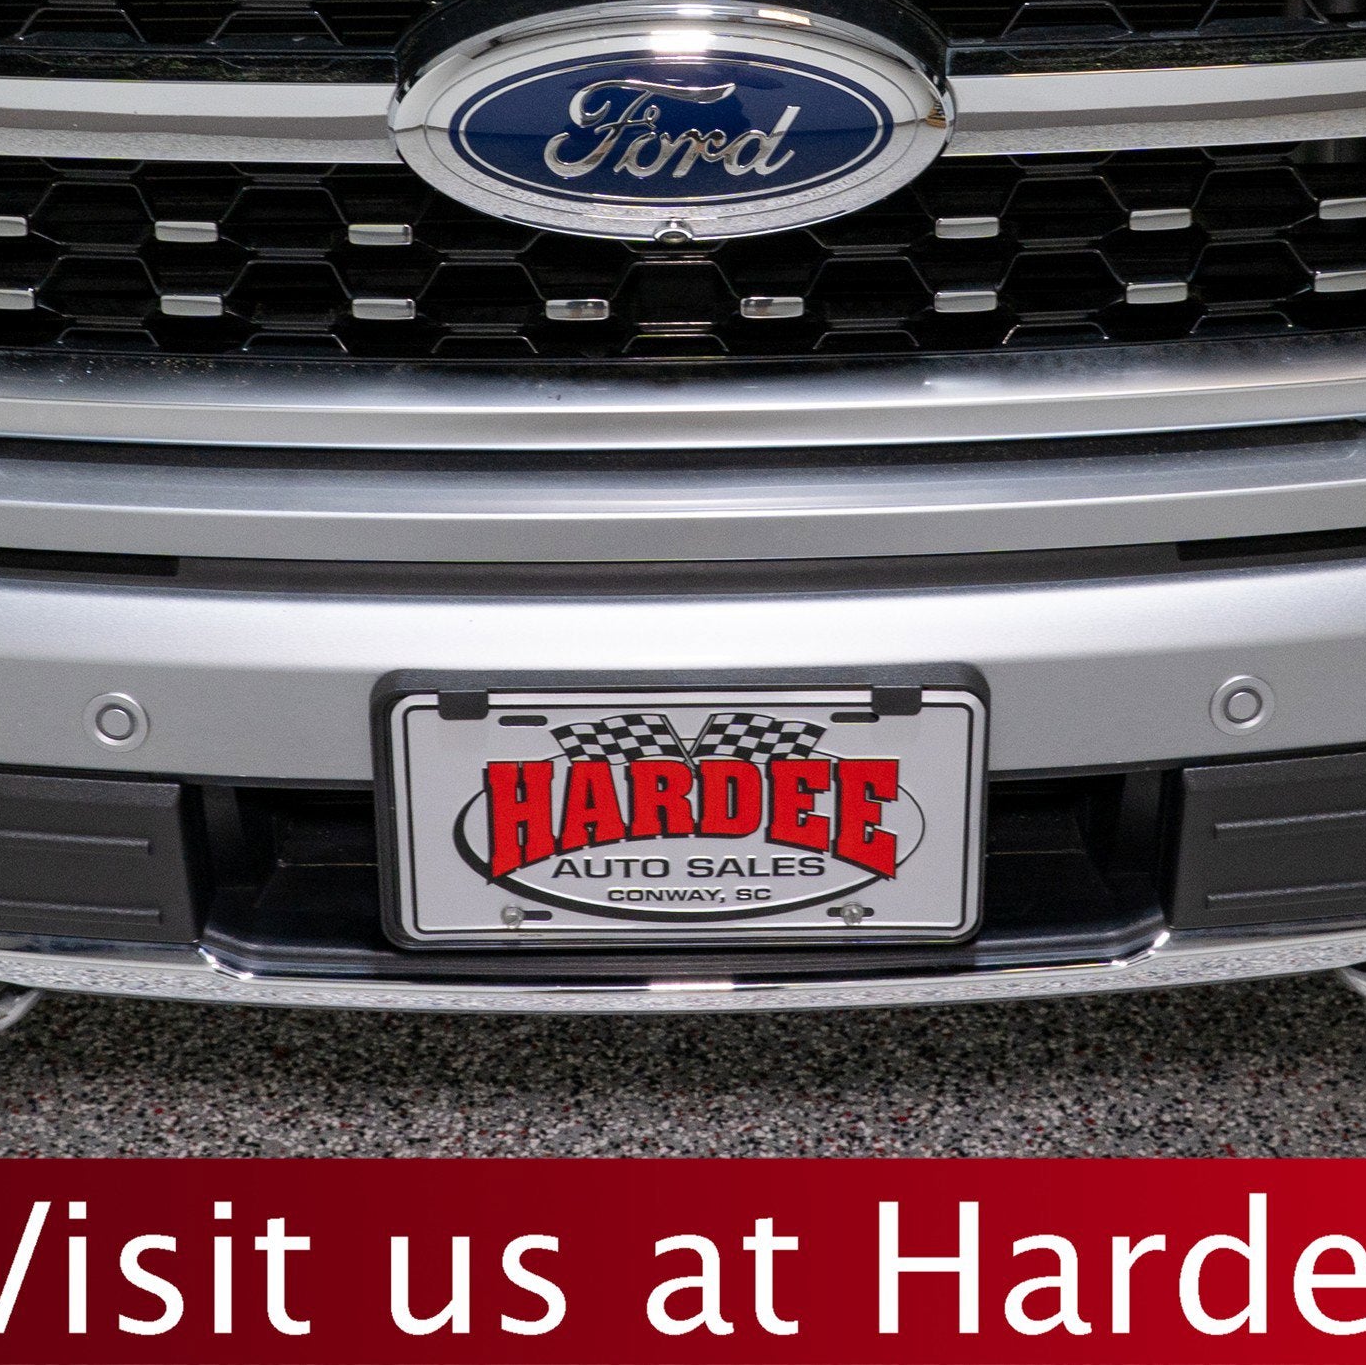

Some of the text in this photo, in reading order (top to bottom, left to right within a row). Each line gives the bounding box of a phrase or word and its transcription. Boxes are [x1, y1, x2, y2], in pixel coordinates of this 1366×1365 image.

[543, 79, 800, 180] Ford
[483, 758, 899, 882] HARDEE
[551, 855, 826, 879] AUTO SALES
[607, 887, 772, 903] CONWAY, SC
